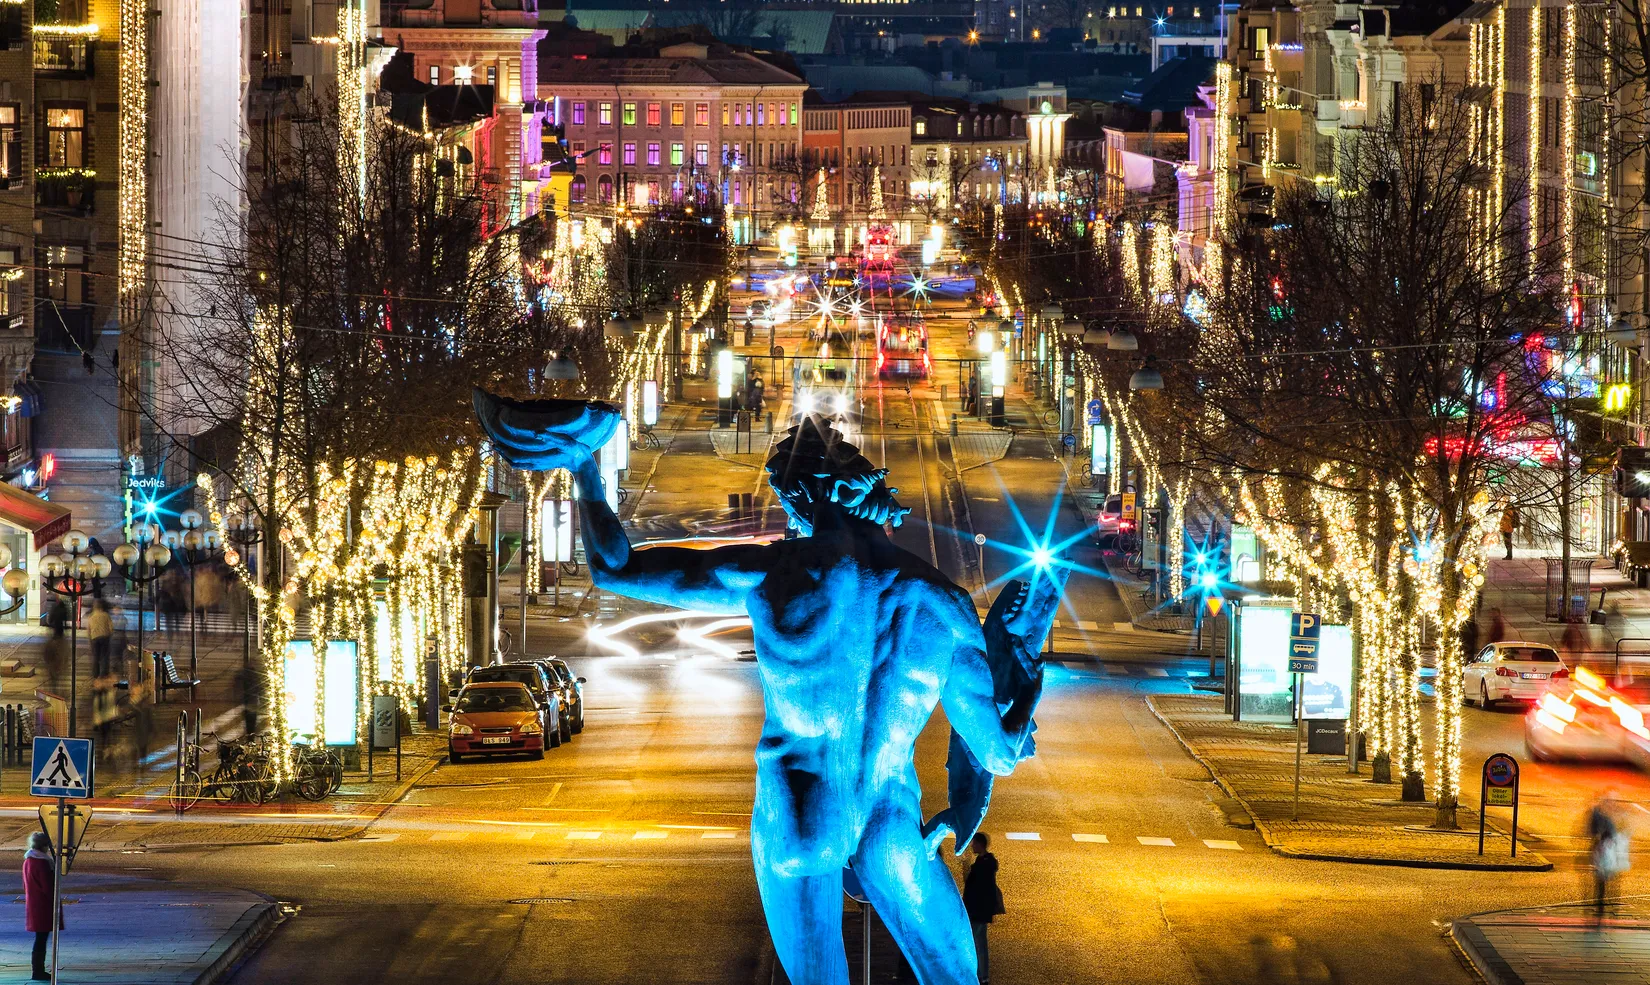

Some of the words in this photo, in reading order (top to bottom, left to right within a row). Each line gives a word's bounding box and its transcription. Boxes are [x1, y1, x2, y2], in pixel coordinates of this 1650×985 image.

[128, 478, 165, 488] Jedviks
[1299, 615, 1315, 635] P
[1292, 662, 1302, 670] 30
